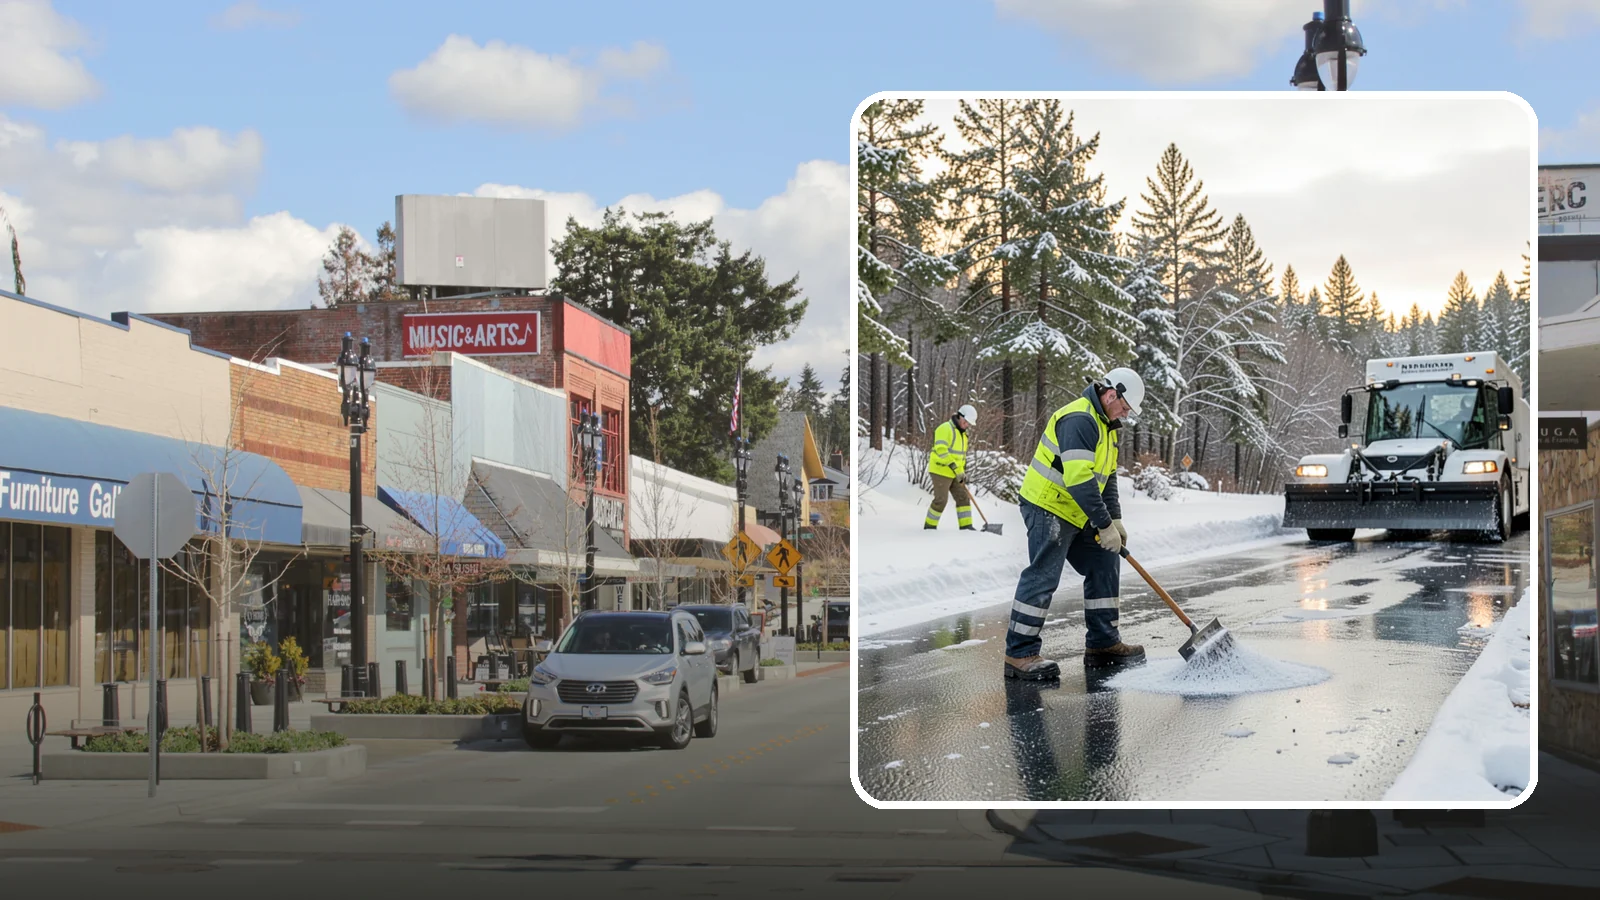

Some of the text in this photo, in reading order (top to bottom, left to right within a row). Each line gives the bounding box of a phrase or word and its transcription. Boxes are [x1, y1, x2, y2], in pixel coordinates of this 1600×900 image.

[409, 323, 519, 348] MUSIC&ARTS
[0, 472, 122, 519] Furniture Gal
[453, 563, 479, 574] SUSHI
